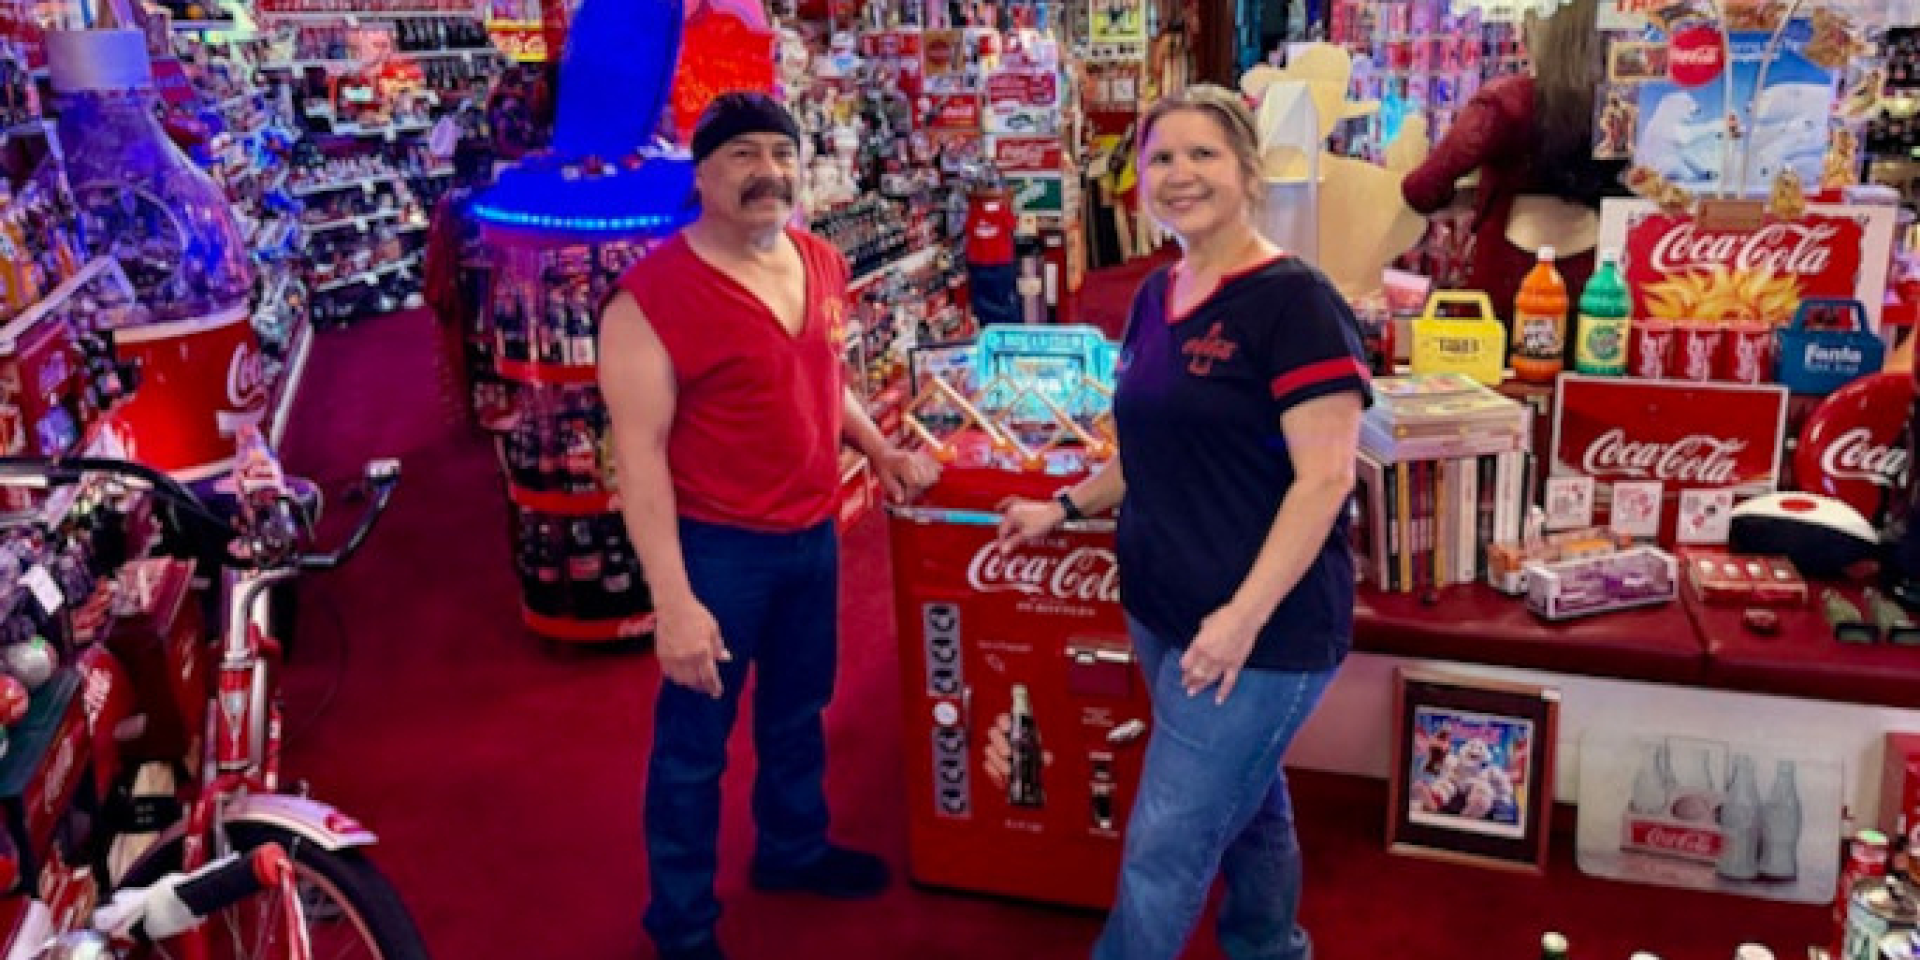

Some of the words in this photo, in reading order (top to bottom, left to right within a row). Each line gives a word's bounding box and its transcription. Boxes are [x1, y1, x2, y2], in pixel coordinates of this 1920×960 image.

[1651, 221, 1840, 275] Coca-Cola
[1804, 342, 1862, 365] Fanta
[1583, 428, 1748, 484] Coca-Cola
